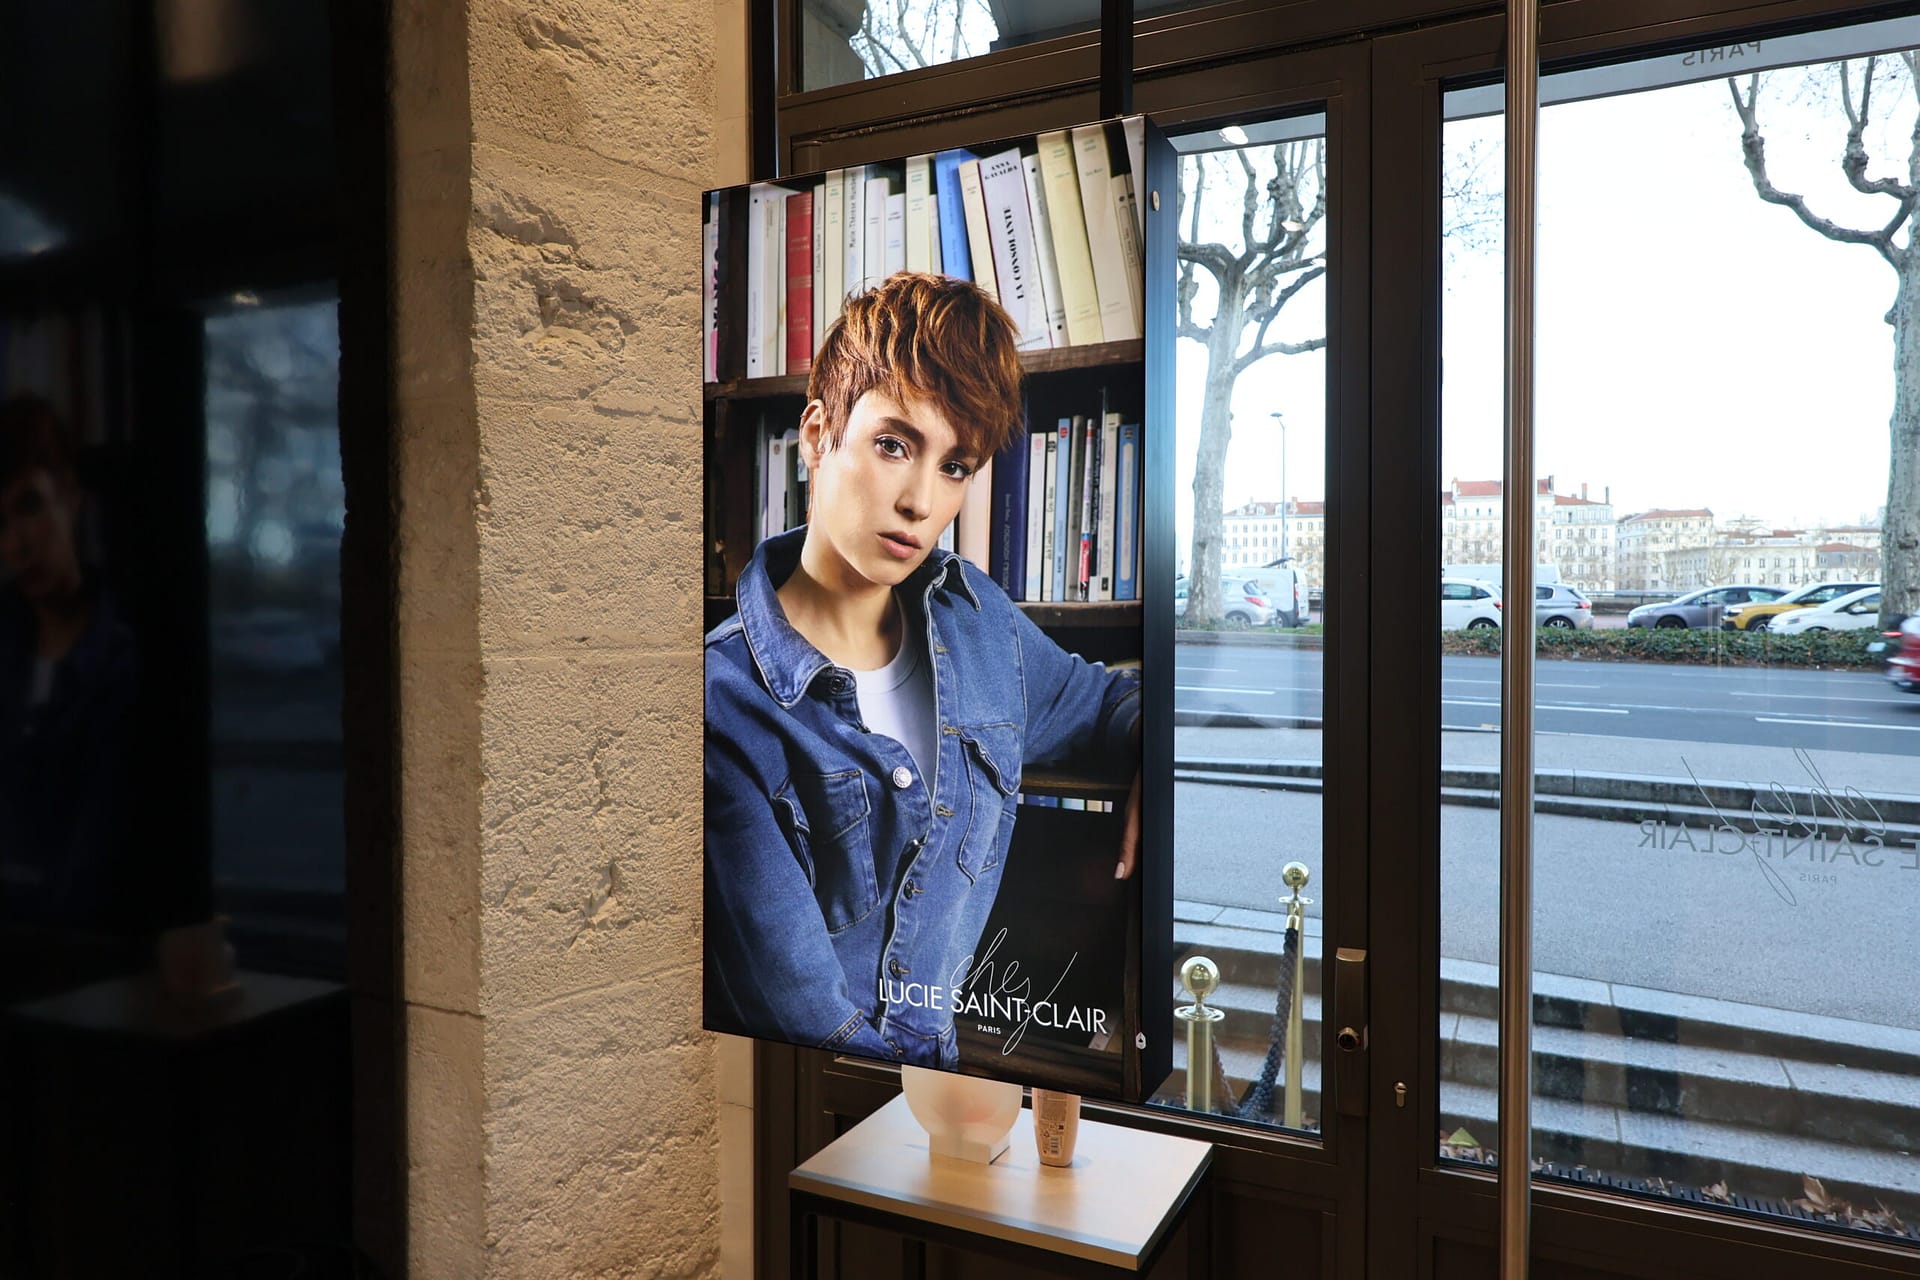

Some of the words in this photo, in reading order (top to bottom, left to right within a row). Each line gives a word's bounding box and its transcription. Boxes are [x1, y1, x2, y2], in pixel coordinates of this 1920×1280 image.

[879, 978, 943, 1011] LUCIE
[950, 988, 1108, 1035] SAINT-CLAIR
[977, 1024, 1002, 1035] PARIS
